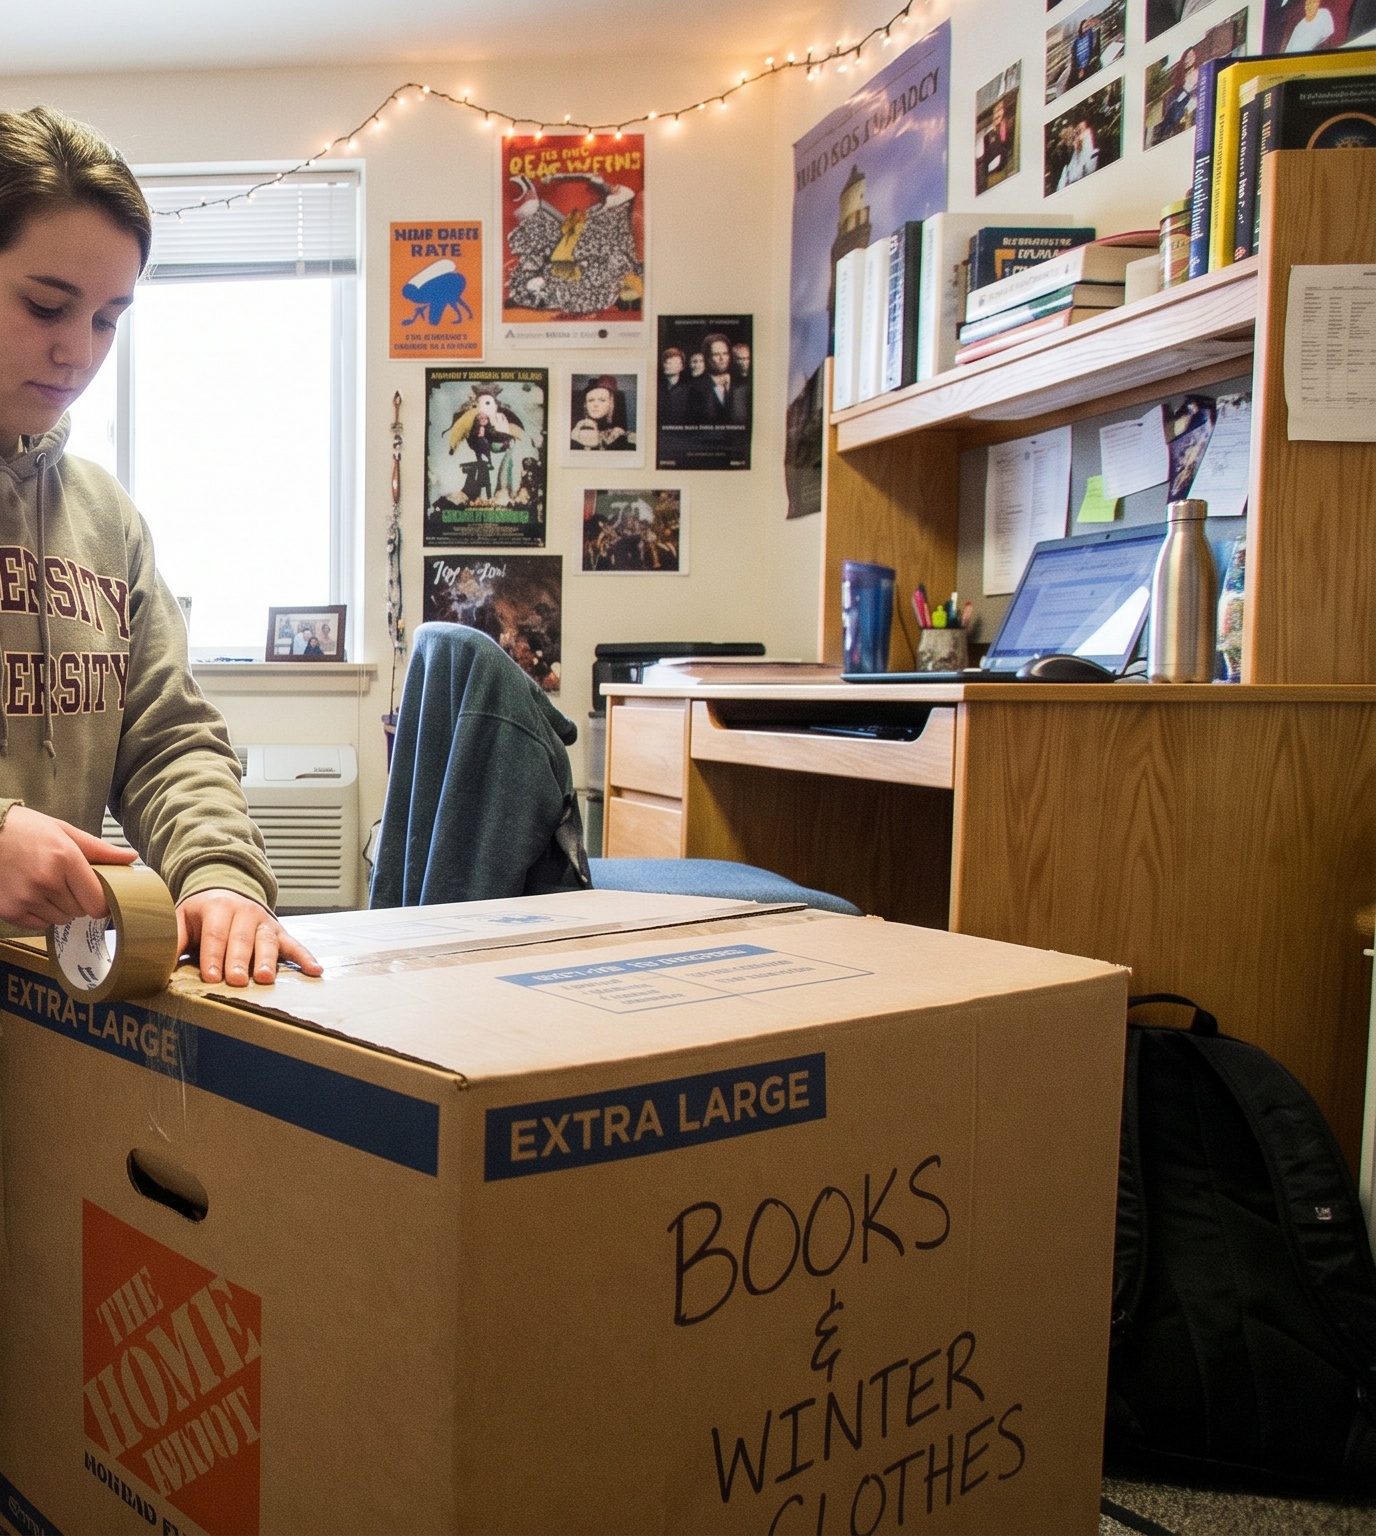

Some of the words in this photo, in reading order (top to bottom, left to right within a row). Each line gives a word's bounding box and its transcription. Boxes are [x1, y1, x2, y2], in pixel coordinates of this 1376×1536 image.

[411, 243, 461, 257] RATE
[7, 973, 180, 1066] EXTRA-LARGE
[510, 1106, 664, 1163] EXTRA
[679, 1069, 811, 1133] LARGE
[667, 1155, 951, 1327] BOOKS
[95, 1265, 164, 1347] THE
[83, 1276, 262, 1455] HOME
[710, 1331, 986, 1504] WINTER
